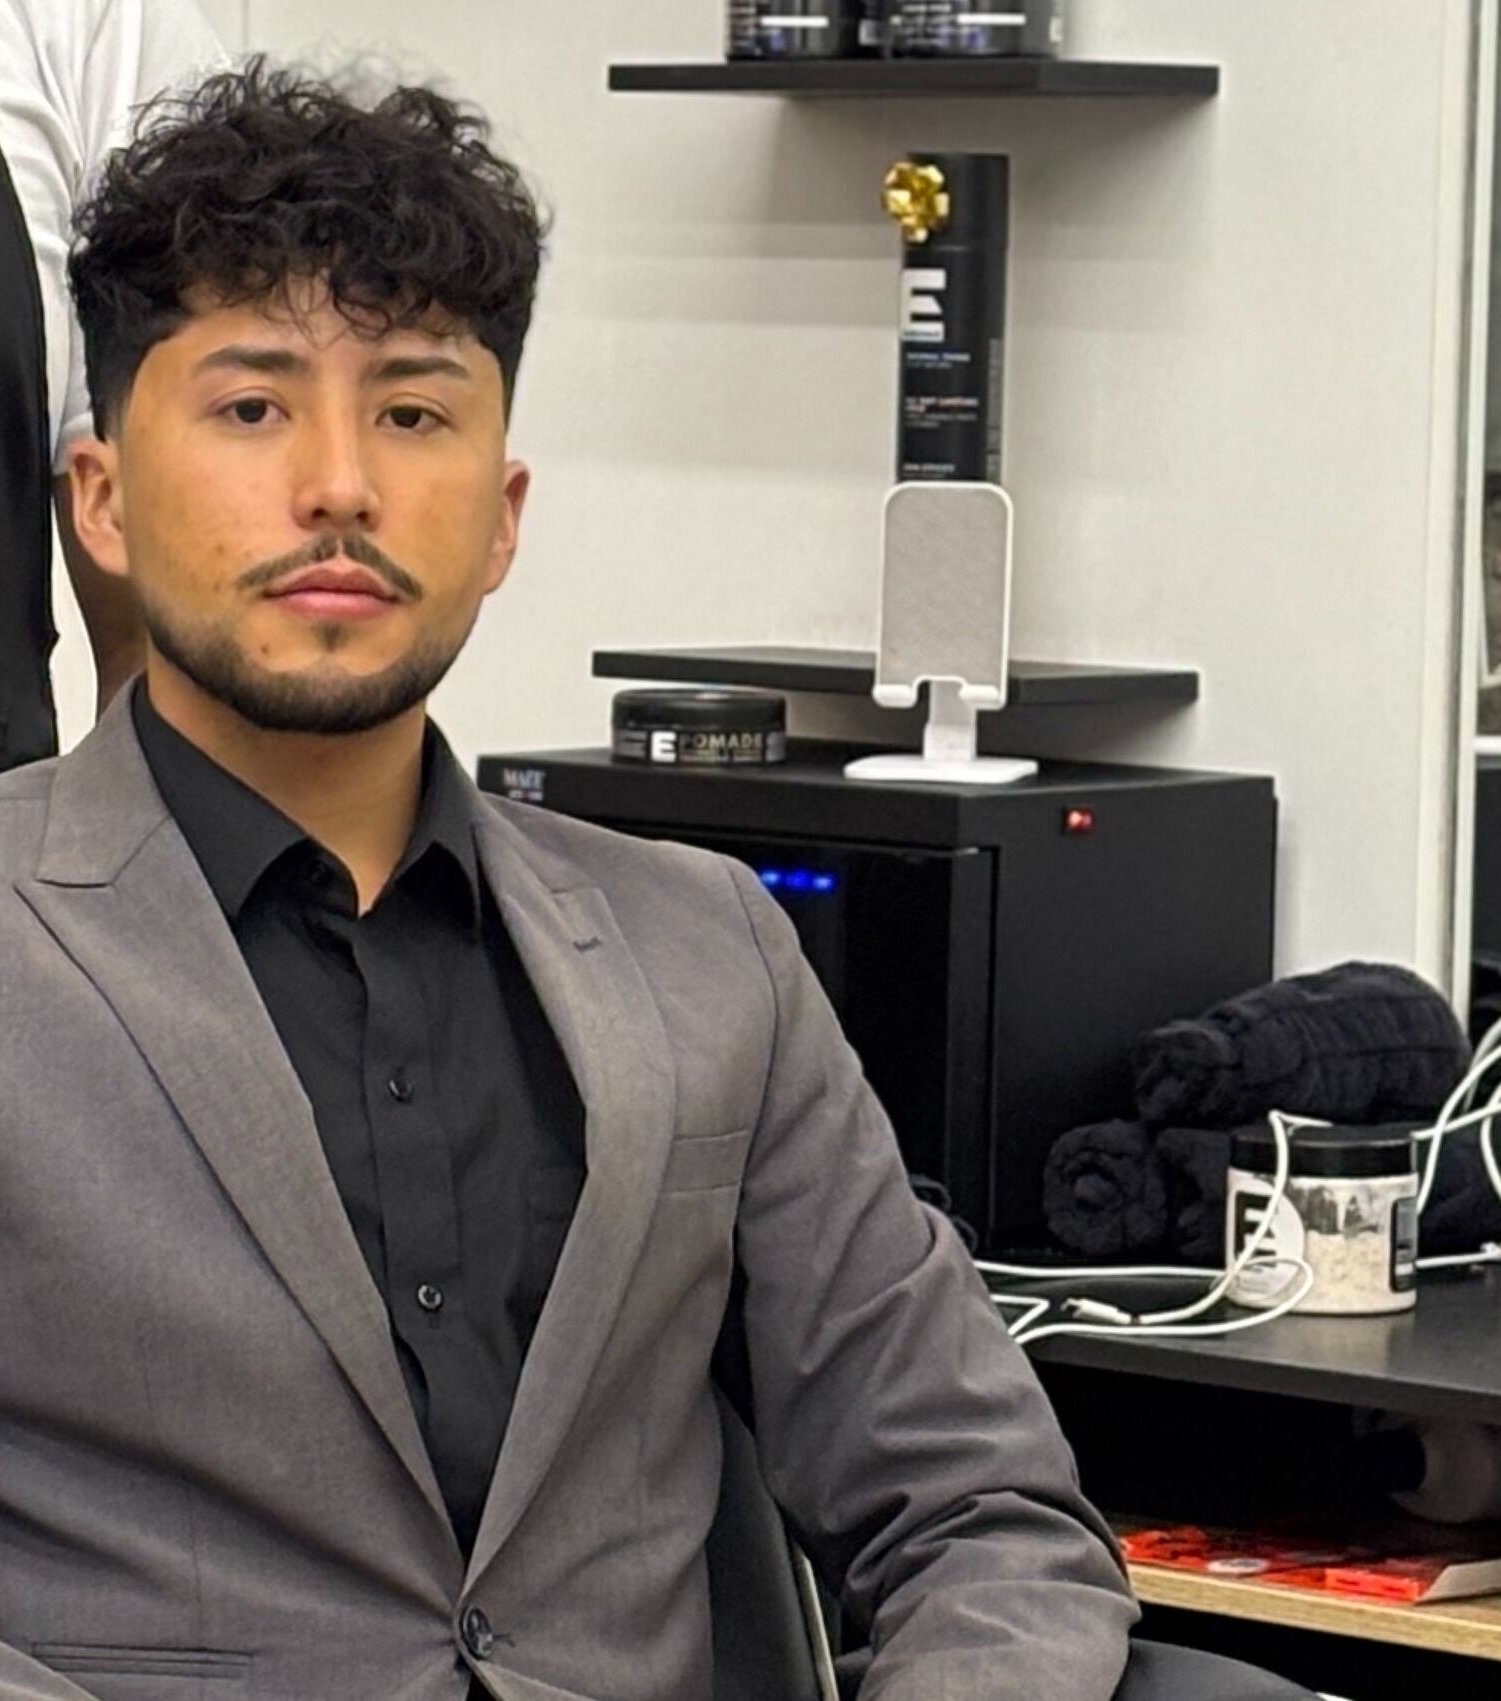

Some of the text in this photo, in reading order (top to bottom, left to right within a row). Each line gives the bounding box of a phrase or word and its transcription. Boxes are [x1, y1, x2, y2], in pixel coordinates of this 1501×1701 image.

[900, 268, 946, 343] E
[651, 731, 677, 763] E
[679, 732, 764, 749] POMADE
